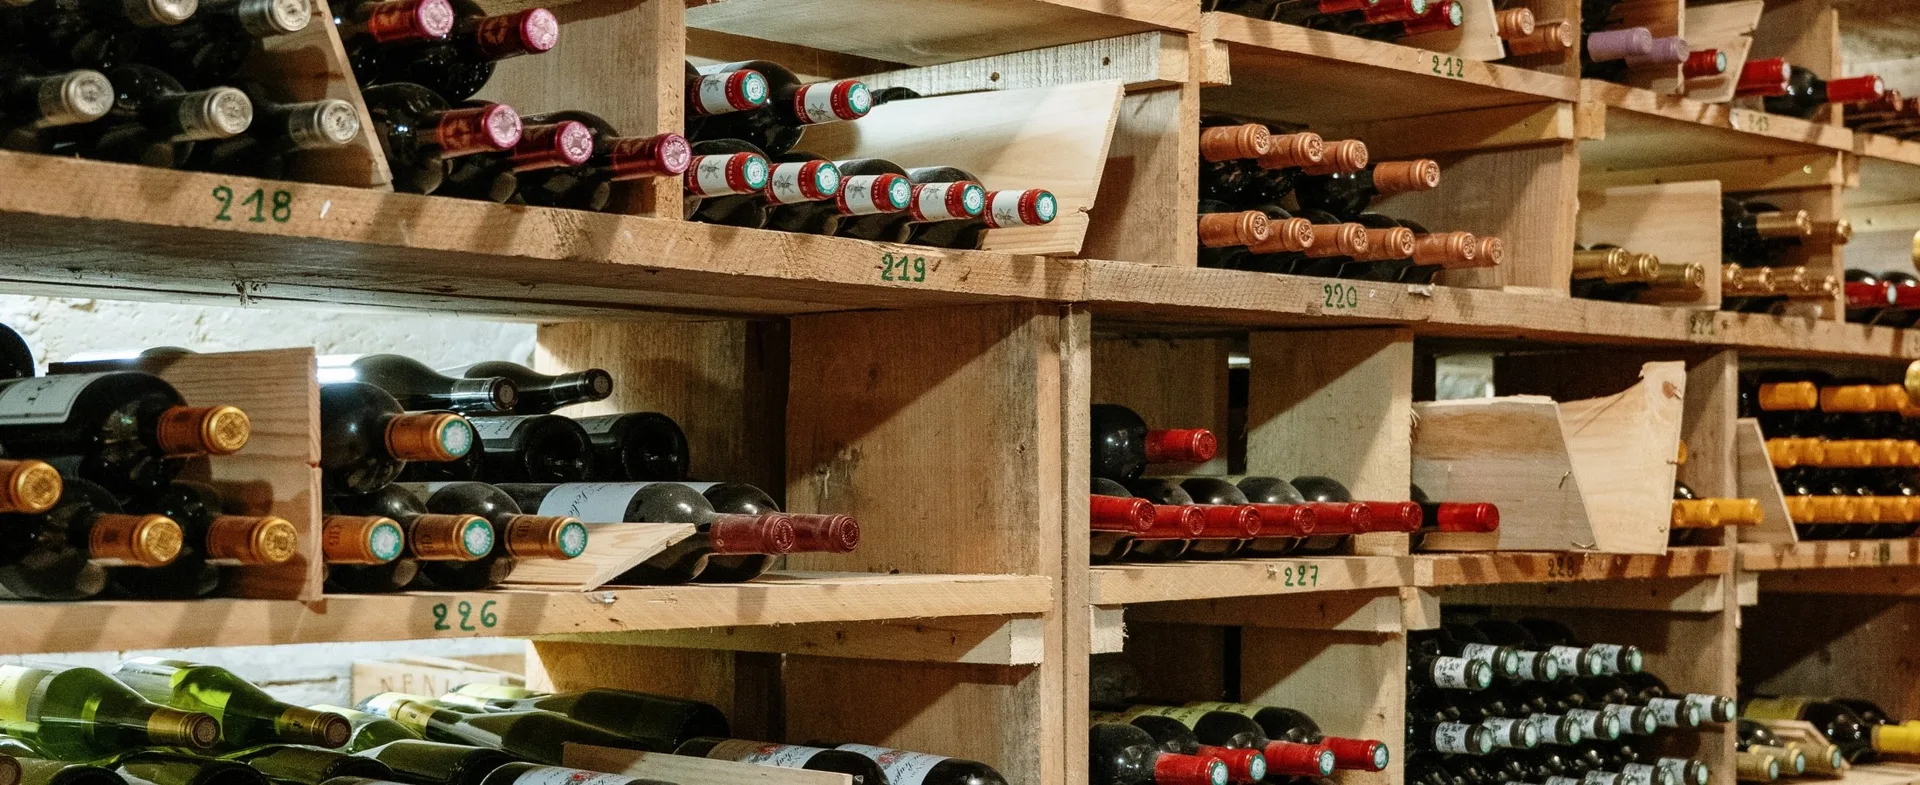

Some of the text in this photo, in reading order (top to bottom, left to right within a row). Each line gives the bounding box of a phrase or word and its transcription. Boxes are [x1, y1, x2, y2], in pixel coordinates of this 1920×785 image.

[1432, 55, 1464, 78] 212
[211, 185, 292, 223] 218
[881, 251, 926, 282] 219
[1323, 282, 1358, 309] 220
[1284, 564, 1319, 588] 227
[432, 599, 498, 632] 226
